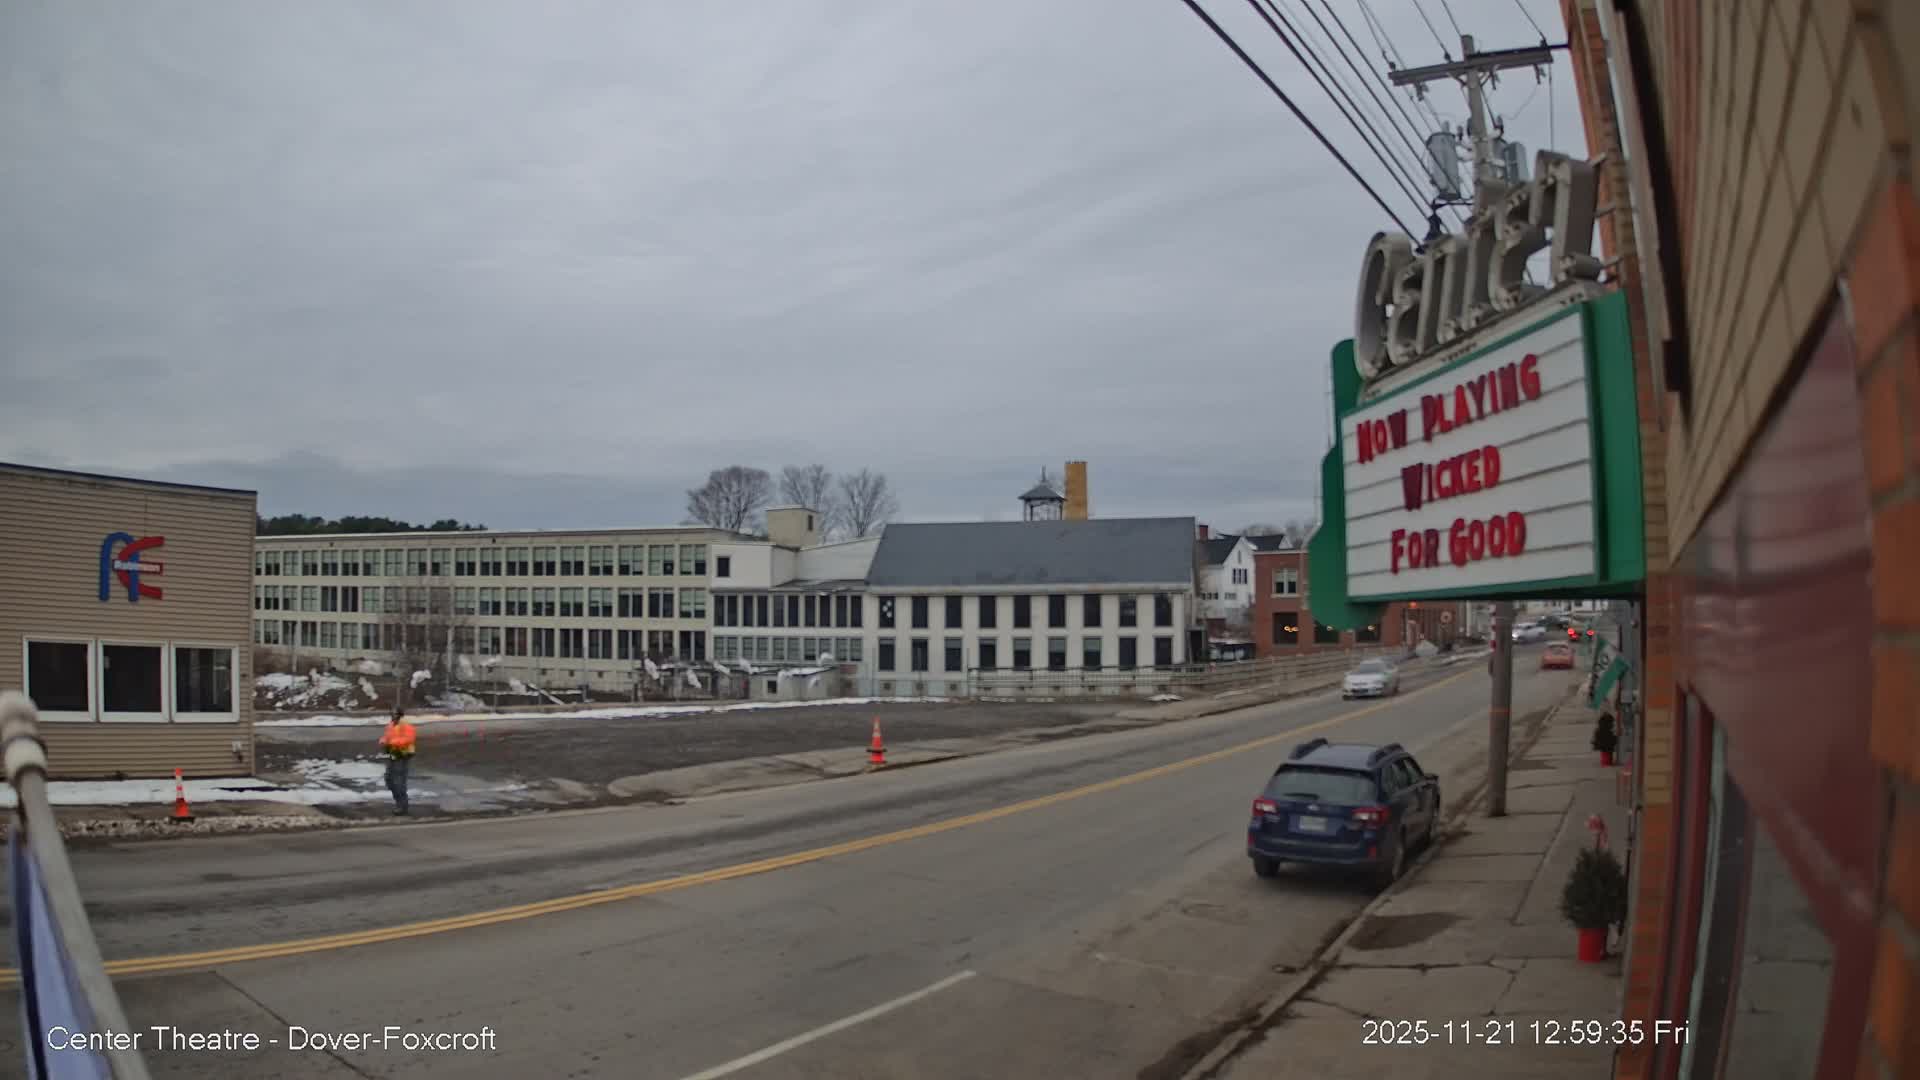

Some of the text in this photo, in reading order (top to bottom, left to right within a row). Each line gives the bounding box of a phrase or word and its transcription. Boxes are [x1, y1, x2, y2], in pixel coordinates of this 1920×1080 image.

[1420, 353, 1541, 443] PLAYING
[1401, 445, 1501, 512] WICKED
[1391, 511, 1527, 575] FOR GOOD
